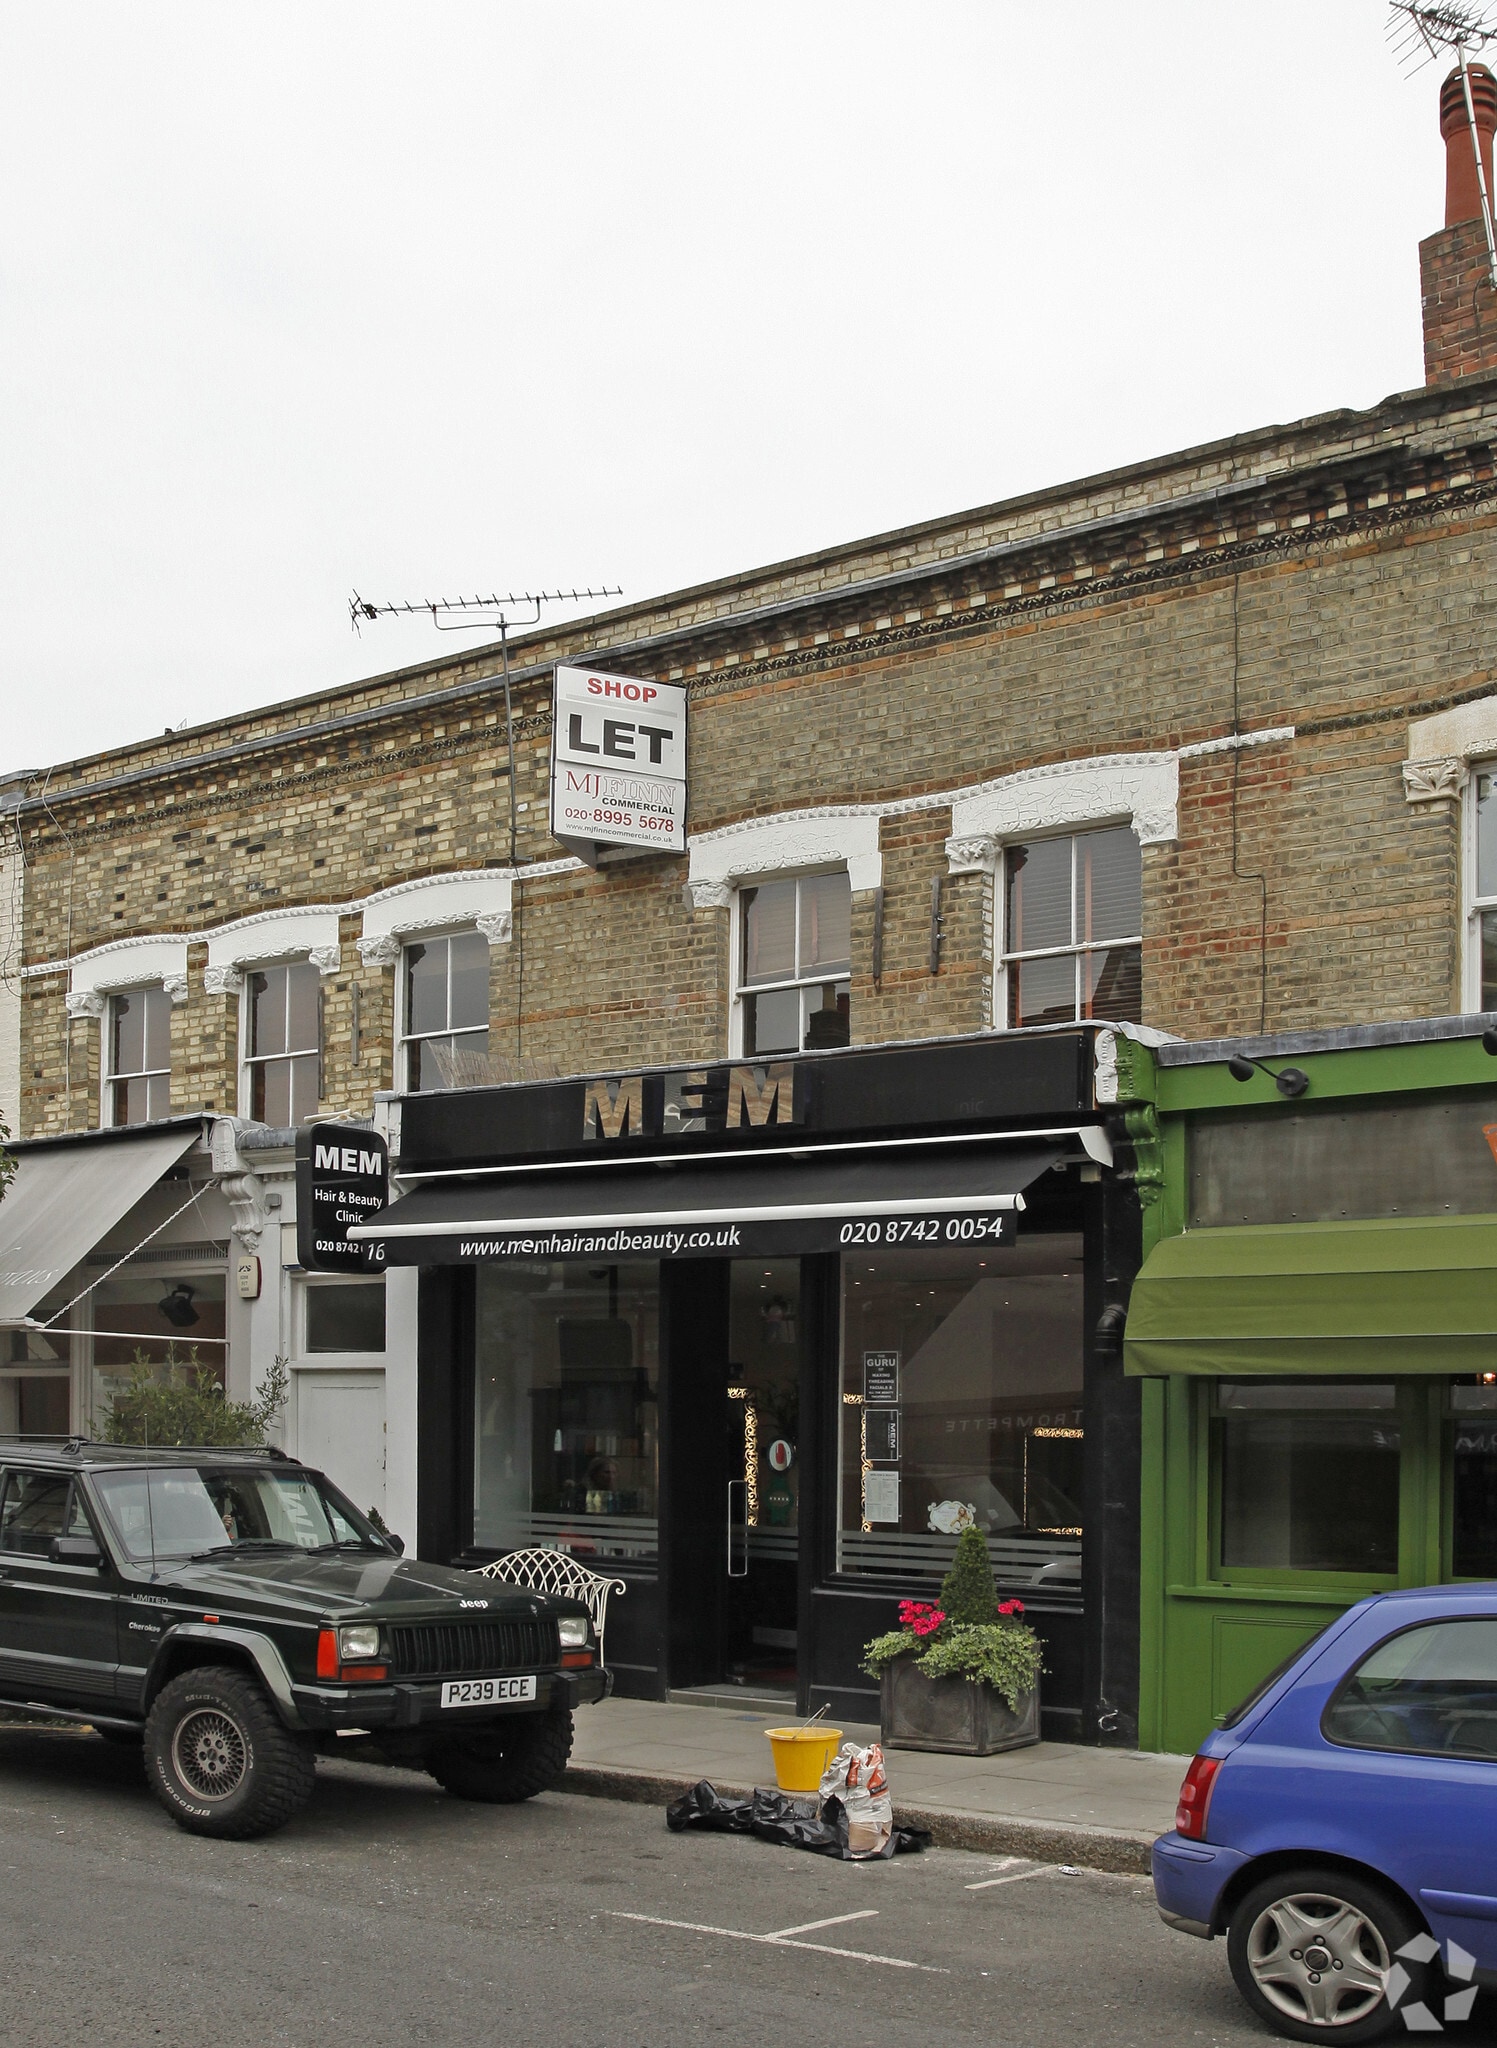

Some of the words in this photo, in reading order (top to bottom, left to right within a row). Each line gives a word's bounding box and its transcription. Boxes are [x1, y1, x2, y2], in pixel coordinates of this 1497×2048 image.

[587, 677, 658, 703] SHOP
[569, 713, 673, 764] LET
[602, 797, 675, 815] COMMERCIAL
[565, 822, 673, 843] www.mjfinncommercial.co.uk
[639, 815, 674, 832] 5678
[583, 1062, 797, 1141] MEM
[314, 1144, 382, 1176] MEM
[315, 1188, 337, 1202] Hair
[338, 1191, 347, 1203] &
[348, 1192, 383, 1210] Beauty
[335, 1210, 364, 1224] Clinic
[839, 1221, 881, 1243] 020
[885, 1219, 939, 1242] 8742
[945, 1216, 1003, 1240] 0054
[316, 1240, 334, 1252] 020
[335, 1241, 359, 1253] 8742
[459, 1225, 741, 1256] www.memhairandbeauty.co.uk
[367, 1243, 385, 1261] 16
[866, 1358, 896, 1367] GURU
[131, 1593, 169, 1605] LIMITED
[460, 1599, 489, 1609] Jeep
[128, 1621, 161, 1633] Cherokee
[448, 1681, 494, 1703] P239
[498, 1679, 530, 1699] ECE
[156, 1755, 211, 1817] BFGoodrich
